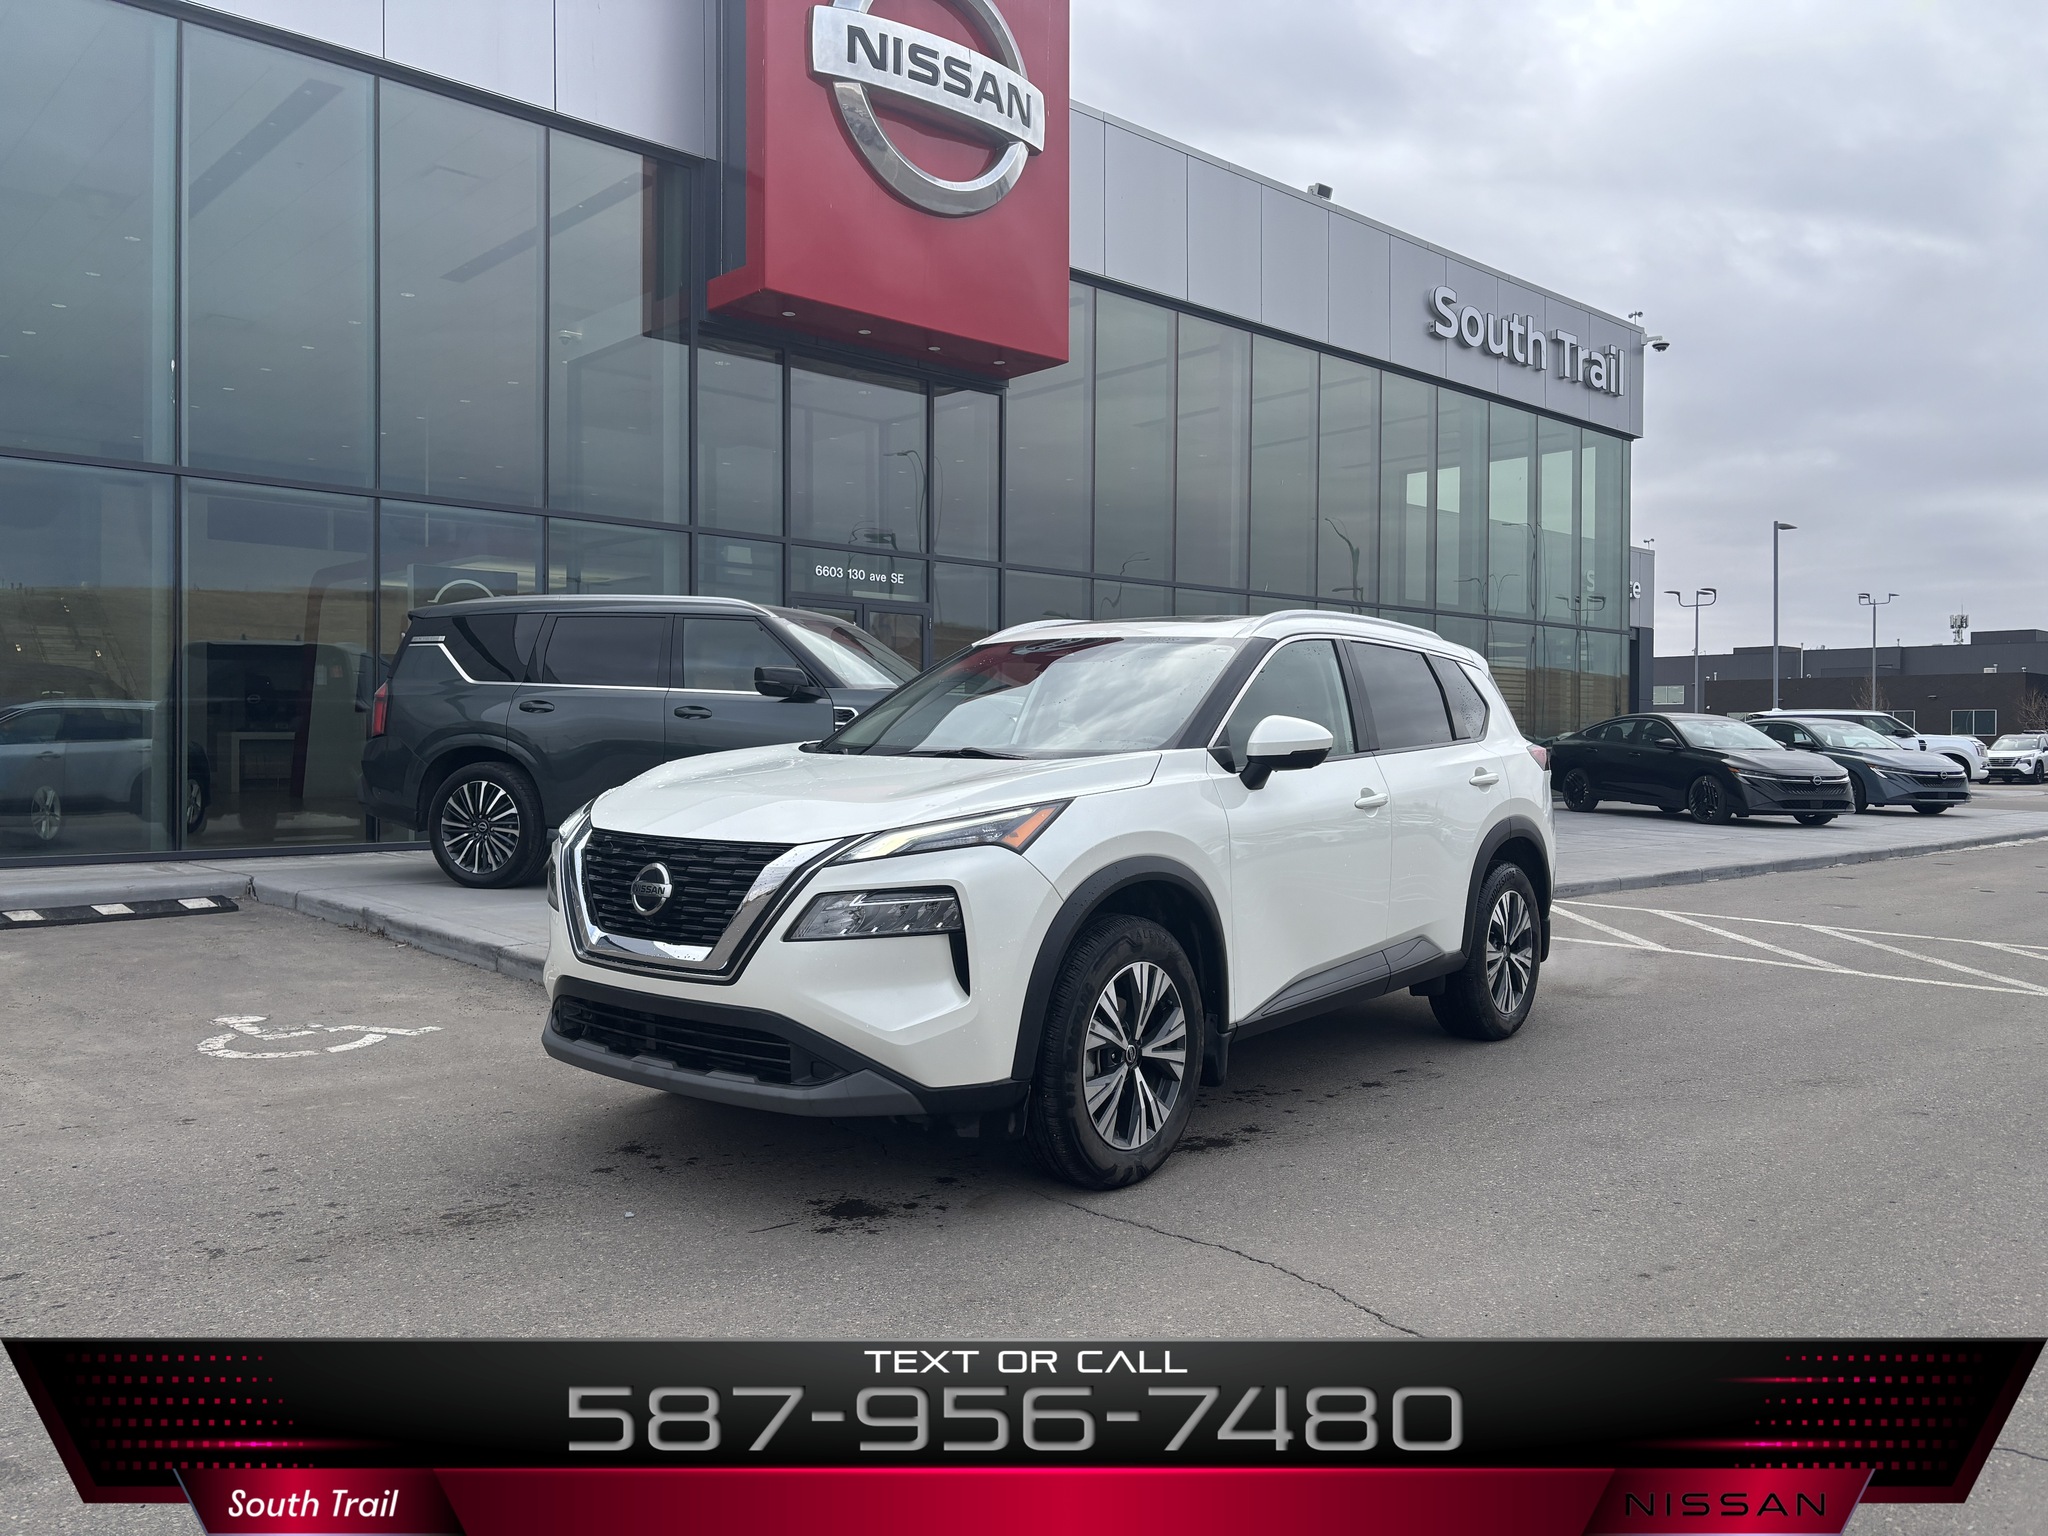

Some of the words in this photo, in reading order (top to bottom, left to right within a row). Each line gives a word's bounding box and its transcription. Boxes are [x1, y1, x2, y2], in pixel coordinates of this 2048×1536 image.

[847, 24, 1032, 129] NISSAN
[1431, 285, 1548, 370] South
[1553, 329, 1625, 396] Trail
[815, 565, 843, 578] 6603
[847, 568, 866, 580] 130
[869, 572, 887, 582] ave
[890, 572, 904, 584] SE
[633, 884, 666, 895] NISSAN
